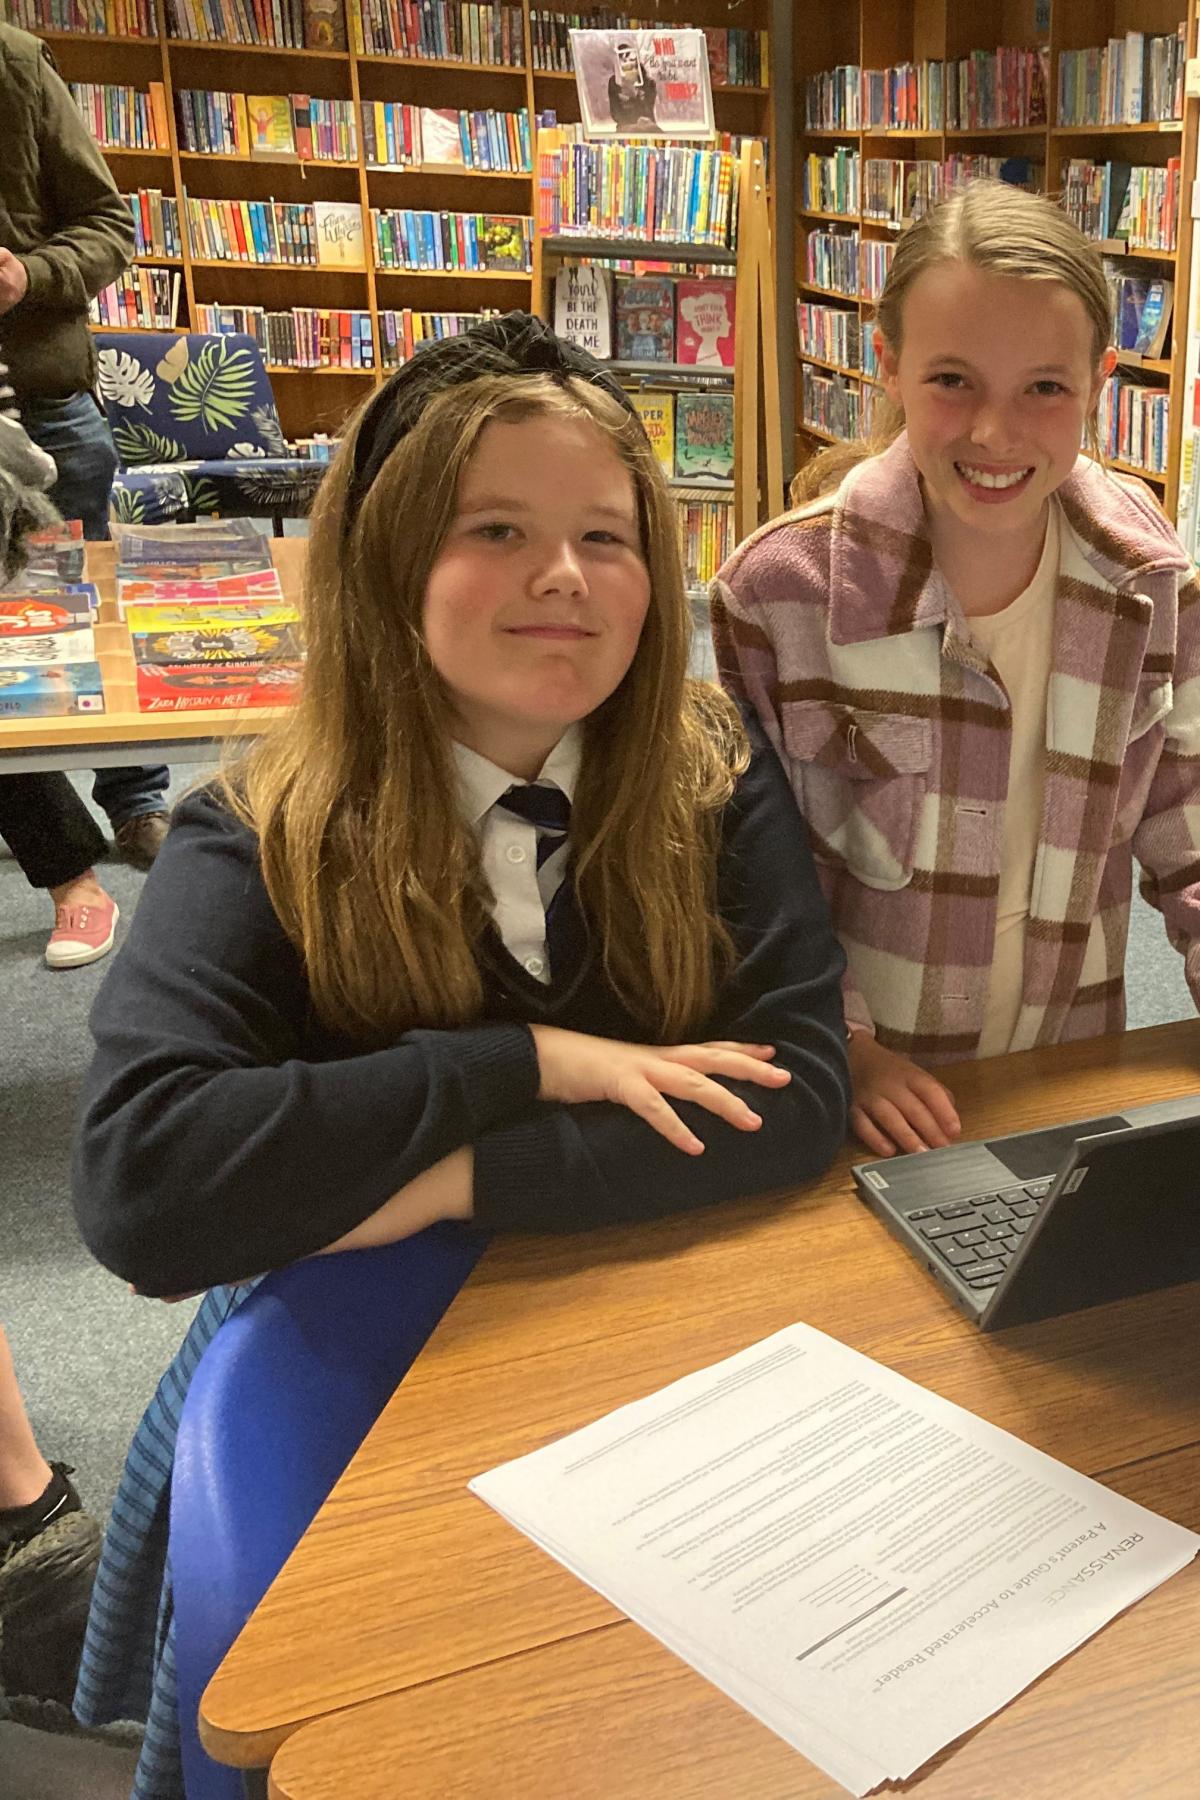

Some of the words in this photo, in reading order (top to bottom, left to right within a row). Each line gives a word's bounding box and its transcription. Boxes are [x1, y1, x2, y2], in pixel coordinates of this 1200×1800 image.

[567, 301, 577, 312] BE
[582, 301, 597, 312] THE
[566, 318, 598, 330] DEATH
[584, 335, 599, 348] ME
[1093, 1521, 1110, 1532] A
[1045, 1528, 1100, 1566] Parent's
[1010, 1561, 1054, 1591] Guide
[1041, 1533, 1144, 1606] RENAISSANCE
[996, 1588, 1017, 1602] to
[920, 1598, 1003, 1657] Accelerated
